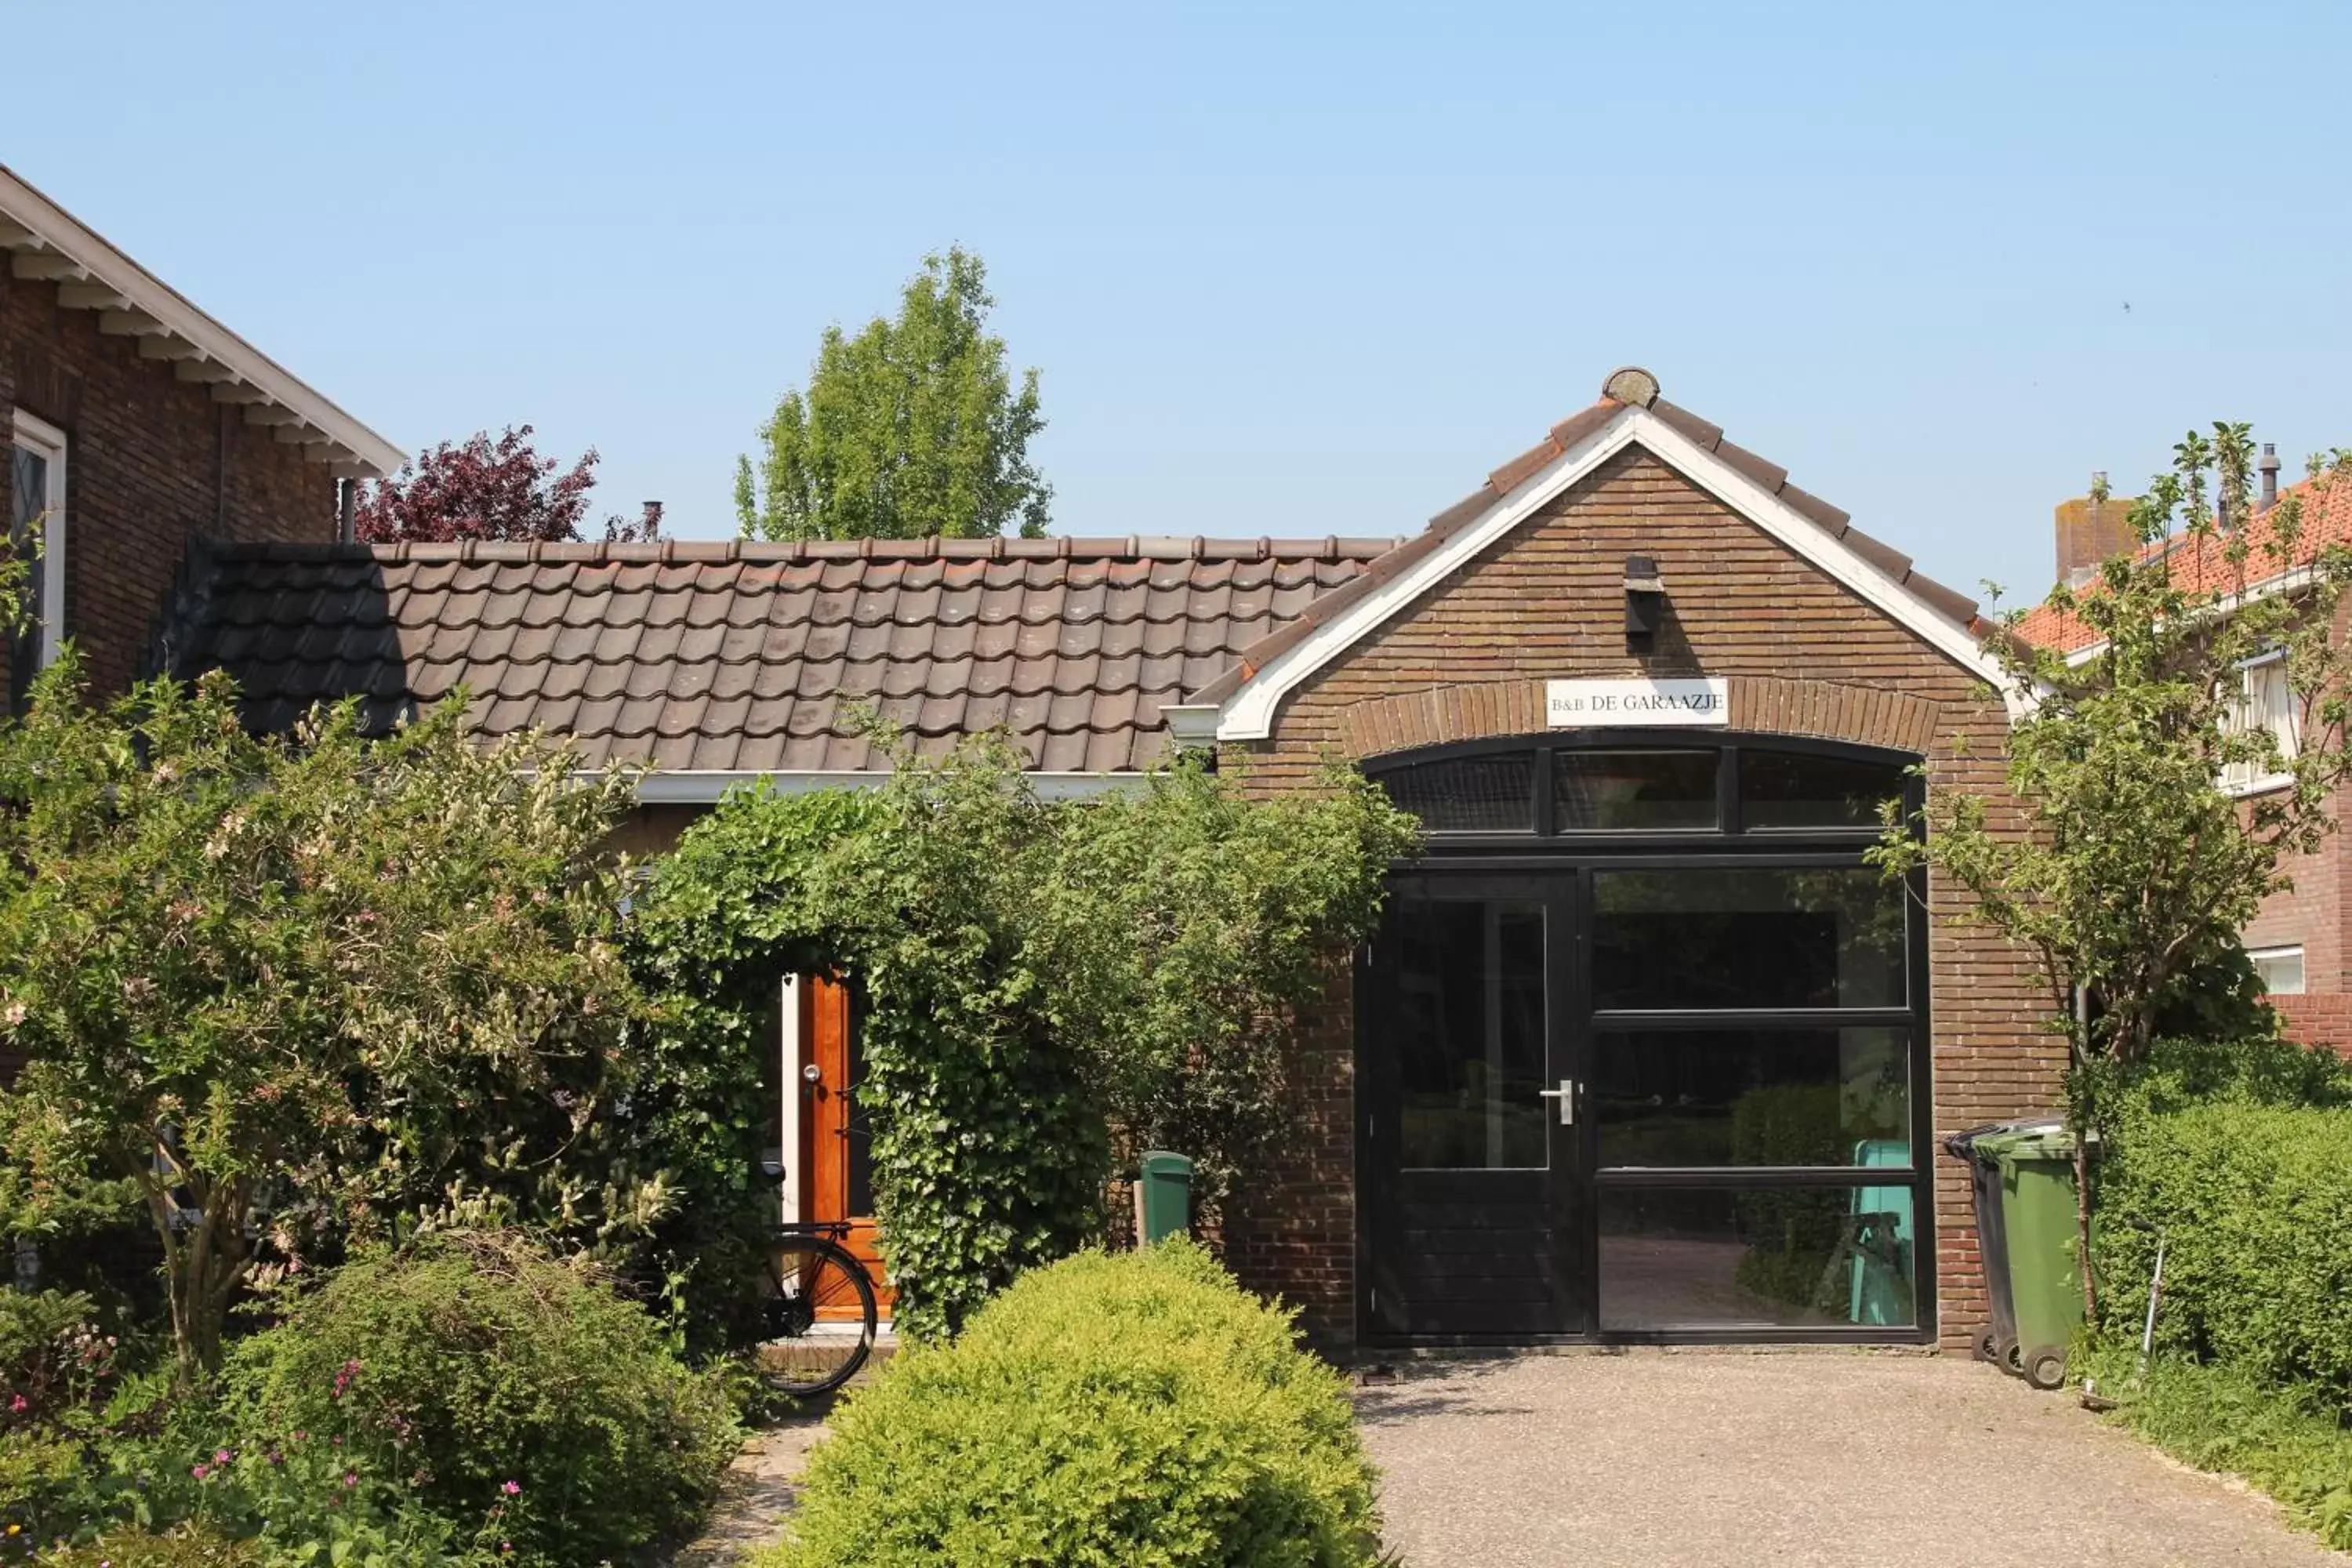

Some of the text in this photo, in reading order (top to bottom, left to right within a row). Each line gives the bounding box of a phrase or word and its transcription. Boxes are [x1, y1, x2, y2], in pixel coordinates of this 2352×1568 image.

[1552, 694, 1724, 711] B&B DE GARAAZJE
